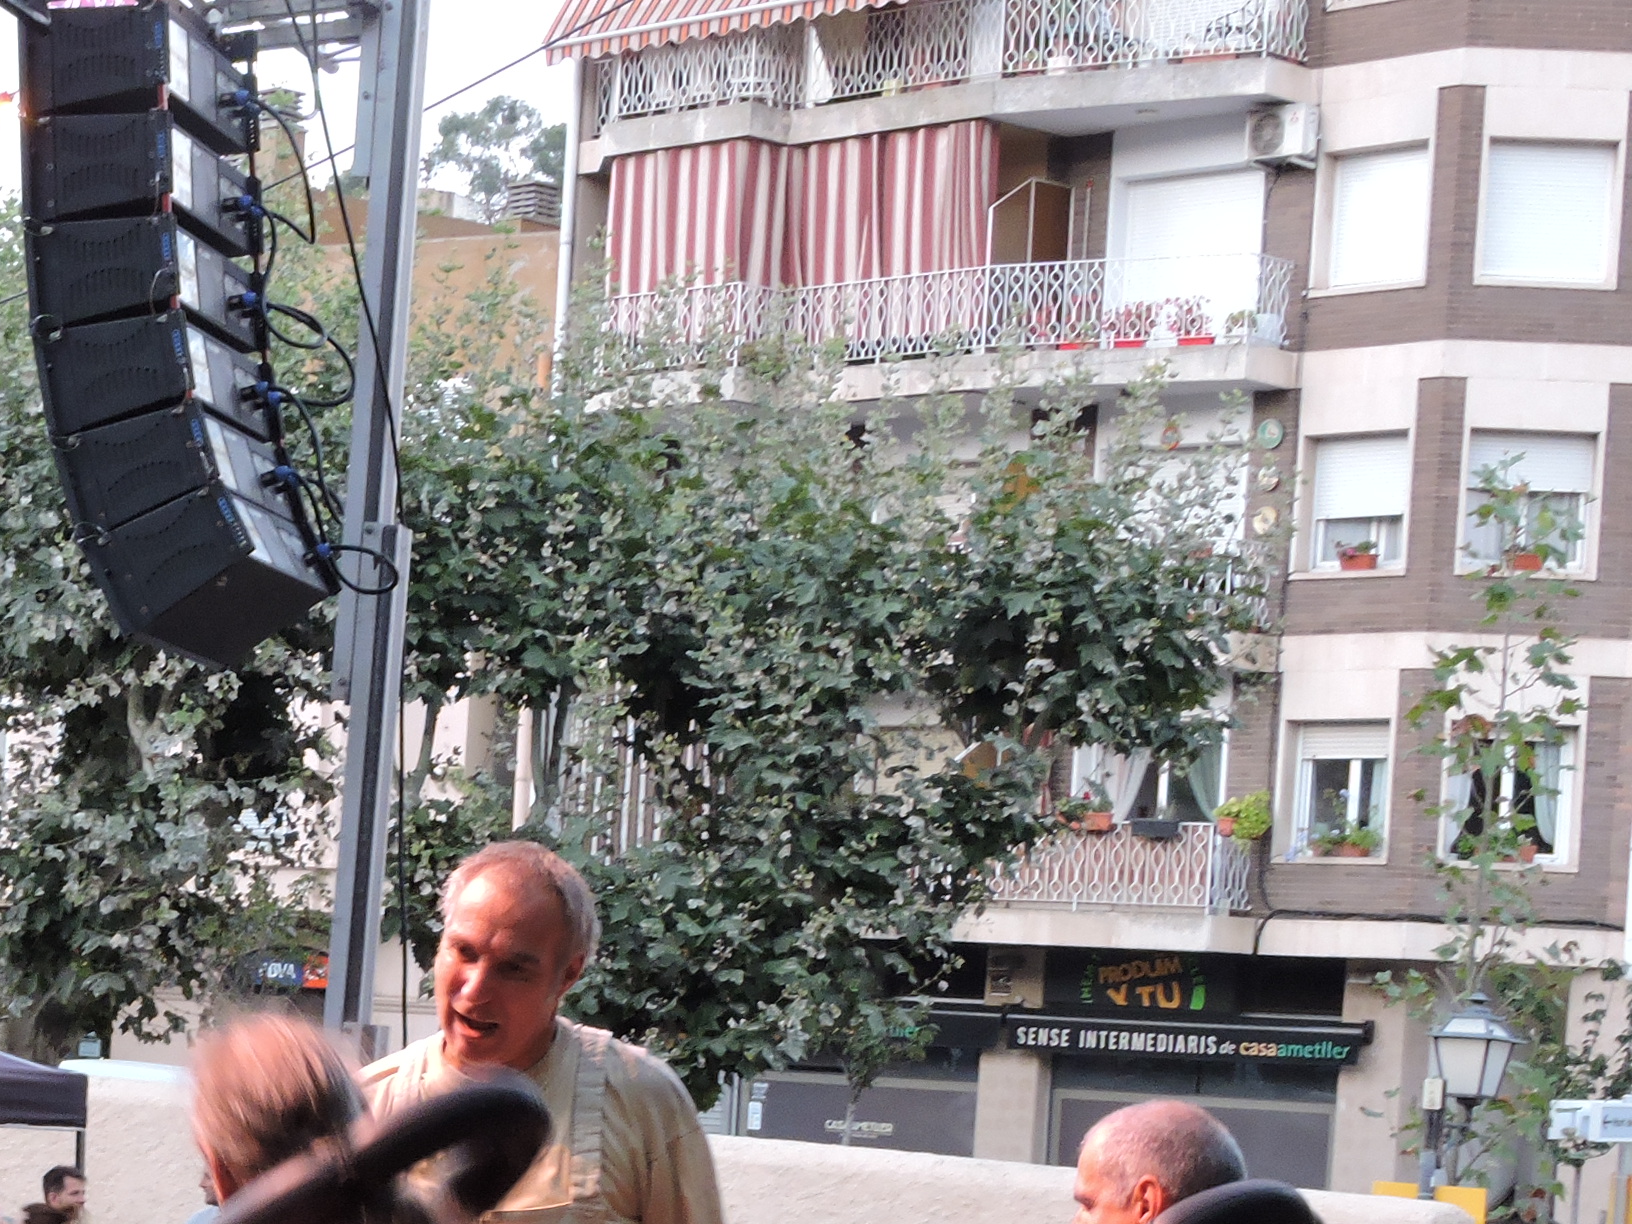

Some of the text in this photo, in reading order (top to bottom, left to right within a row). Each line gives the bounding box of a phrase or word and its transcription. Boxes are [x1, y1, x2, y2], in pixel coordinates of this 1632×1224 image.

[1135, 981, 1182, 1009] TU
[1016, 1026, 1071, 1047] SENSE
[1078, 1029, 1217, 1055] INTERMEDIARIS
[1219, 1040, 1236, 1055] de
